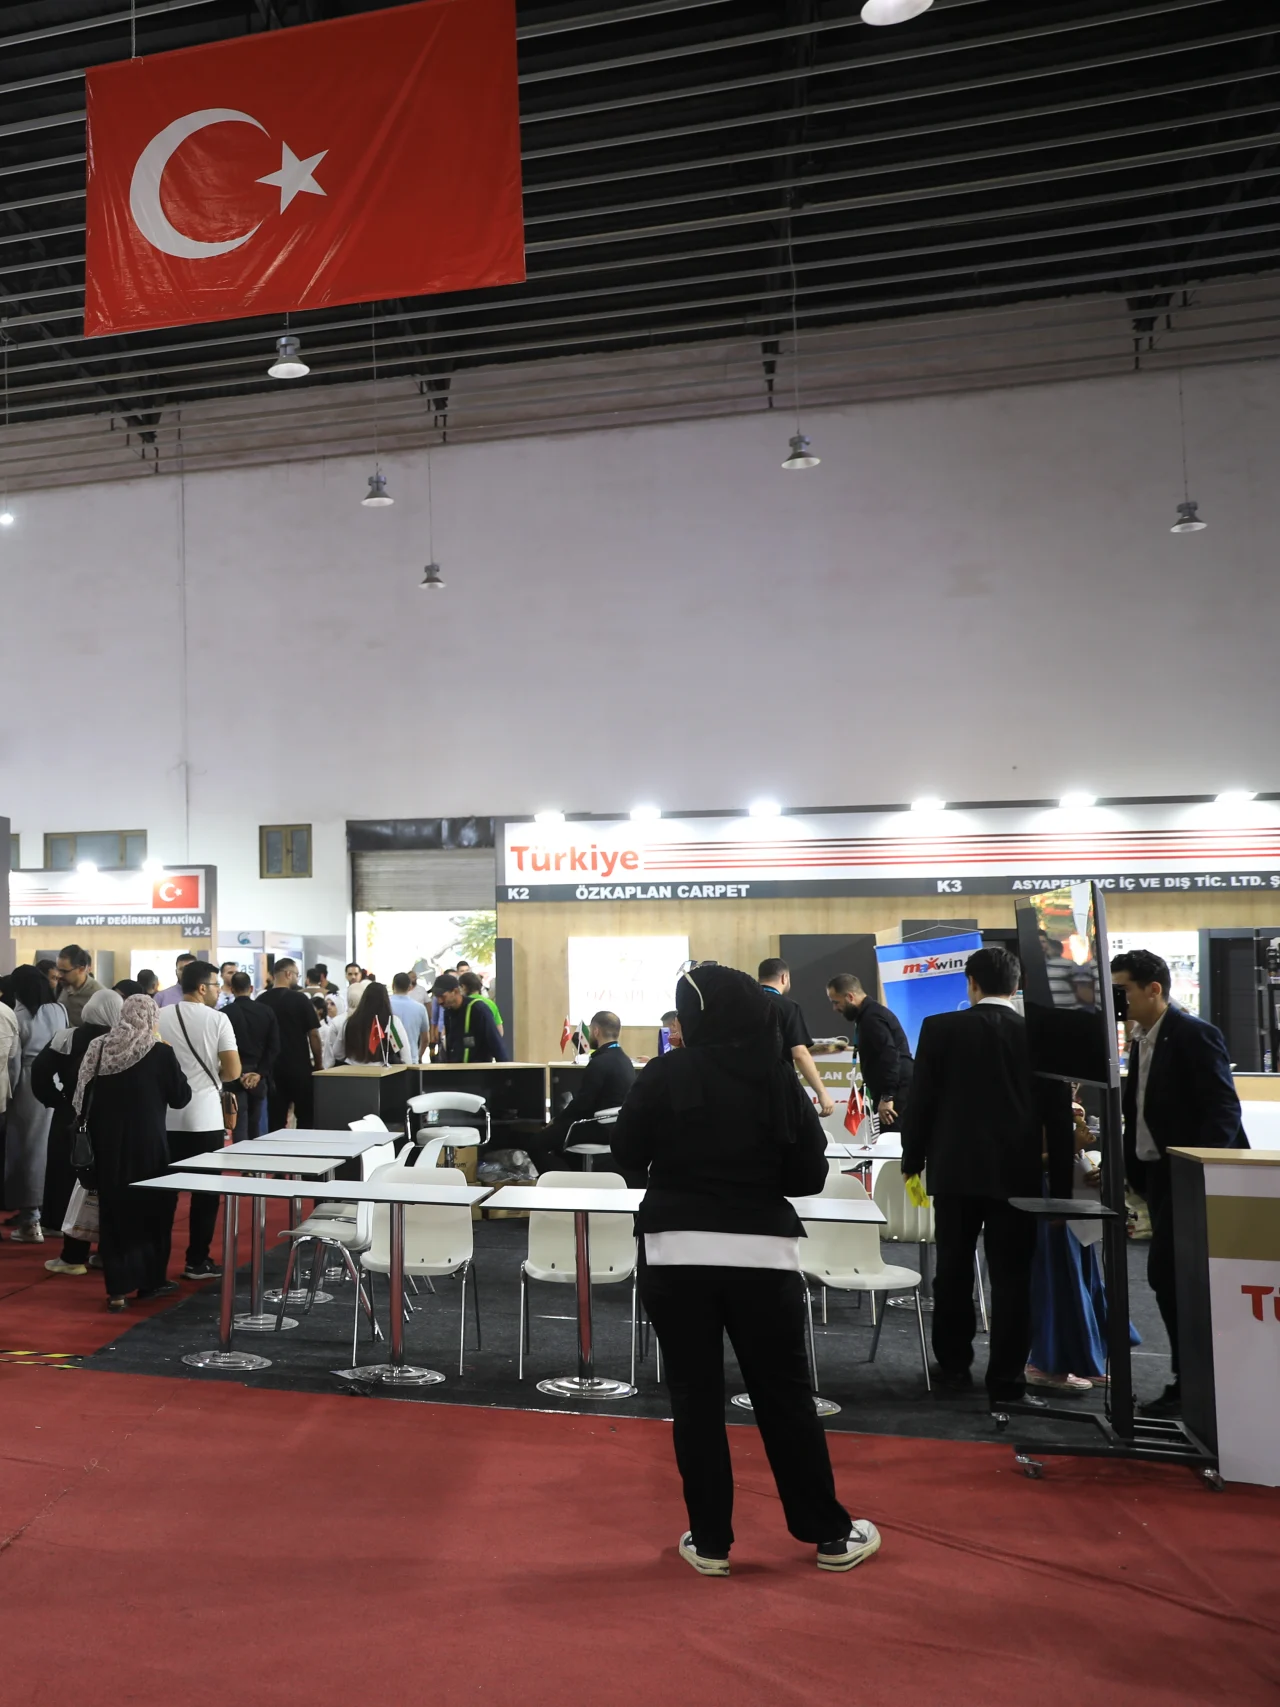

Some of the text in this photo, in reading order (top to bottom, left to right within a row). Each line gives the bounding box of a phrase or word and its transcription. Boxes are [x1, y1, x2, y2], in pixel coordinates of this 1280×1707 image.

[510, 844, 639, 877] Türkiye
[937, 880, 963, 893] K3
[1120, 876, 1136, 891] İÇ
[1139, 877, 1161, 888] VE
[1164, 877, 1191, 889] DIŞ
[1195, 874, 1227, 888] TİC.
[1231, 875, 1266, 887] LTD.
[508, 888, 529, 900] K2
[575, 884, 750, 900] ÖZKAPLAN CARPET
[76, 915, 105, 925] AKTİF
[107, 914, 160, 925] DEĞİRMEN
[162, 914, 203, 925] MAKİNA
[184, 926, 211, 937] X4-2
